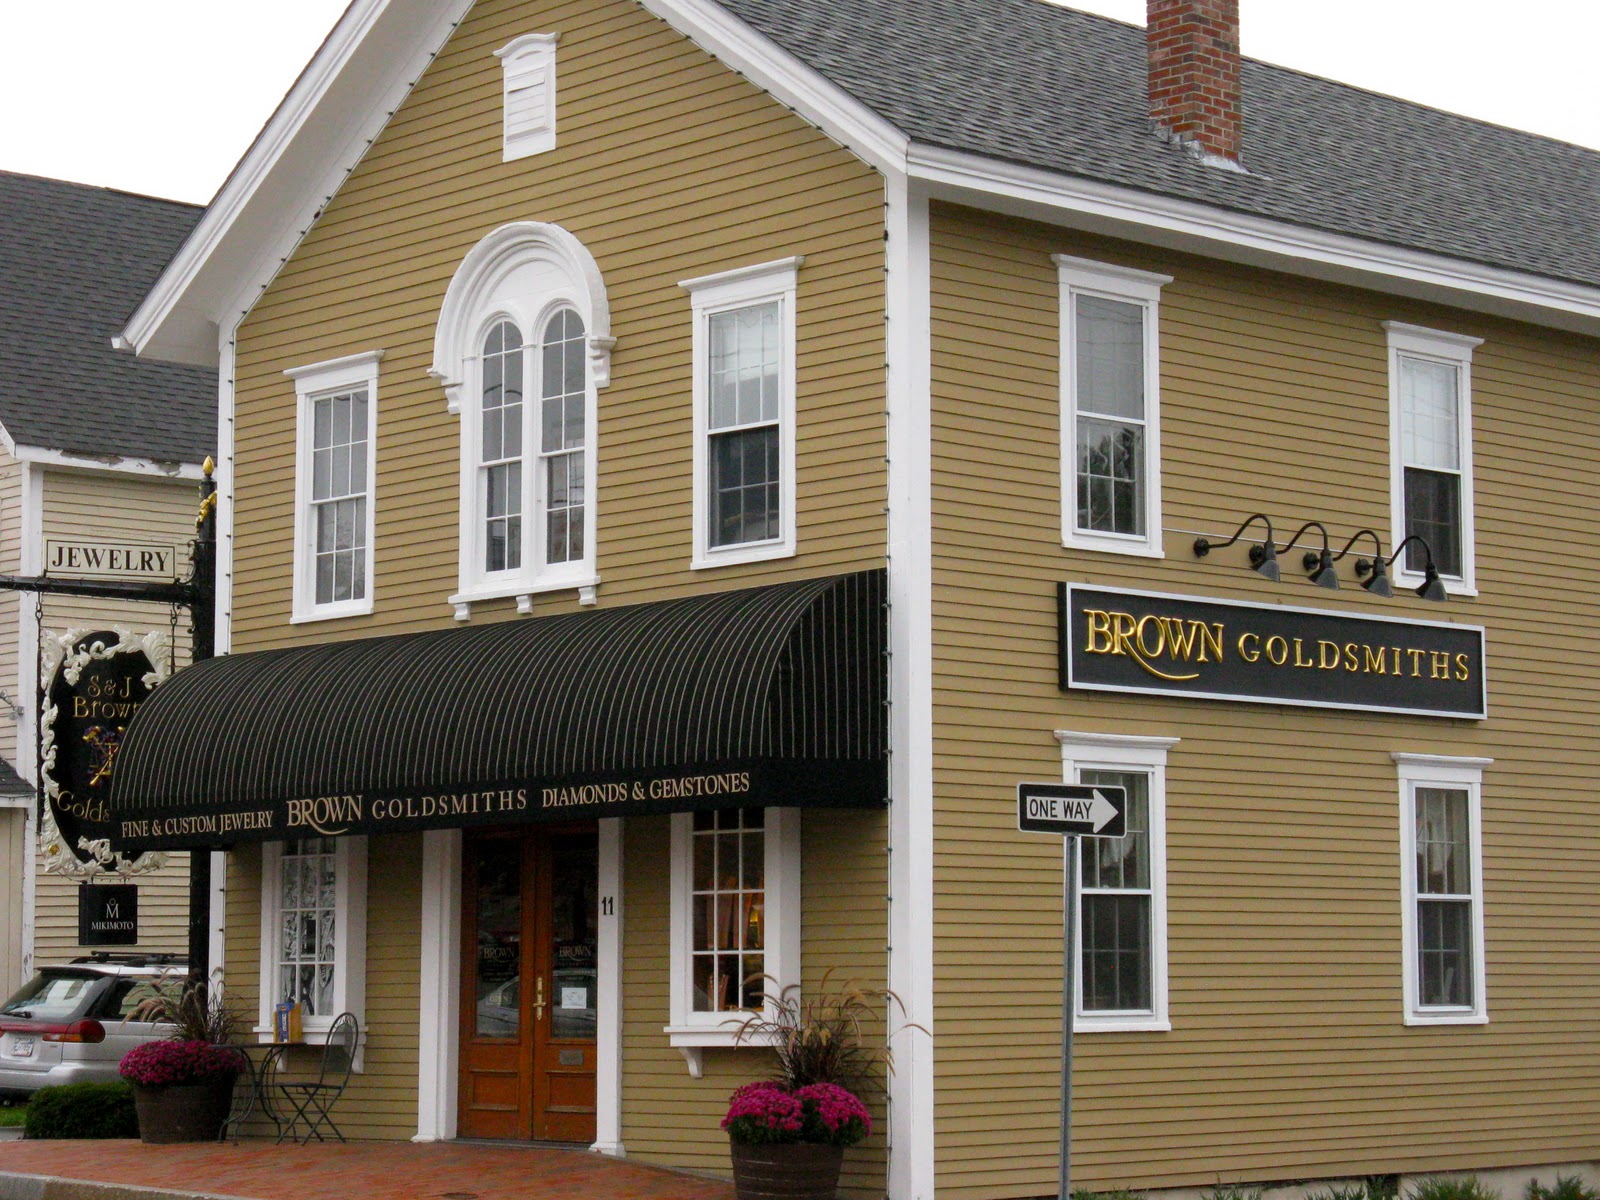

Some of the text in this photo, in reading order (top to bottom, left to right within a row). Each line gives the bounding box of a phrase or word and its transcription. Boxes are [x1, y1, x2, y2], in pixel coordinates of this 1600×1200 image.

[52, 546, 169, 572] JEWELRY
[1083, 609, 1469, 682] BROWN GOLDSMITHS
[87, 675, 132, 698] S & J
[121, 772, 751, 838] FINE & CUSTOM JEWELRY BROWN GOLDSMITHS DIAMONDS & GEMSTONES
[1029, 798, 1093, 820] ONE WAY
[601, 896, 614, 915] 11
[91, 921, 134, 930] MIKIMOTO
